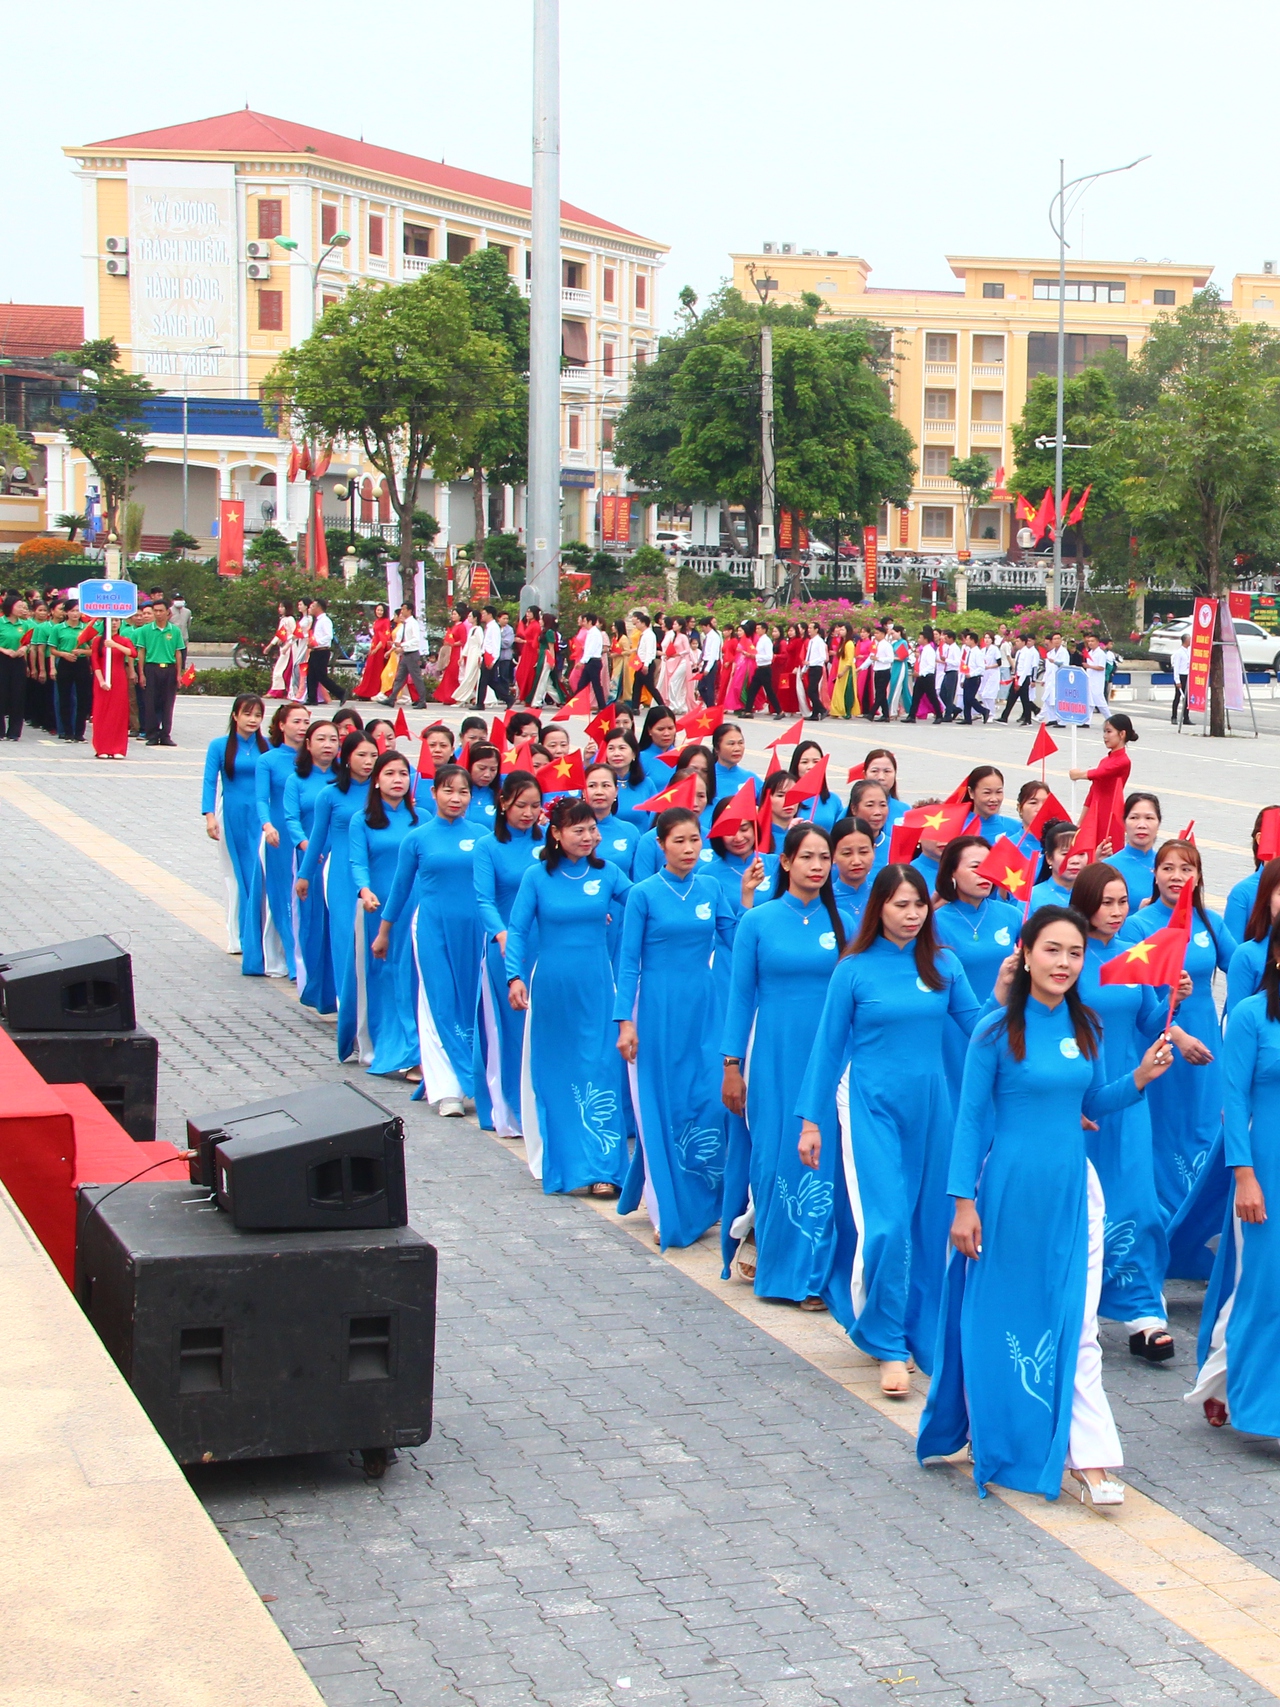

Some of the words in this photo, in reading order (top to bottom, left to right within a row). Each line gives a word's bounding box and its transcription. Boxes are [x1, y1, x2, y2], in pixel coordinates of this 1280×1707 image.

[139, 235, 180, 261] TRÁCH
[145, 272, 180, 299] HÀNH
[152, 311, 188, 337] SÁNG
